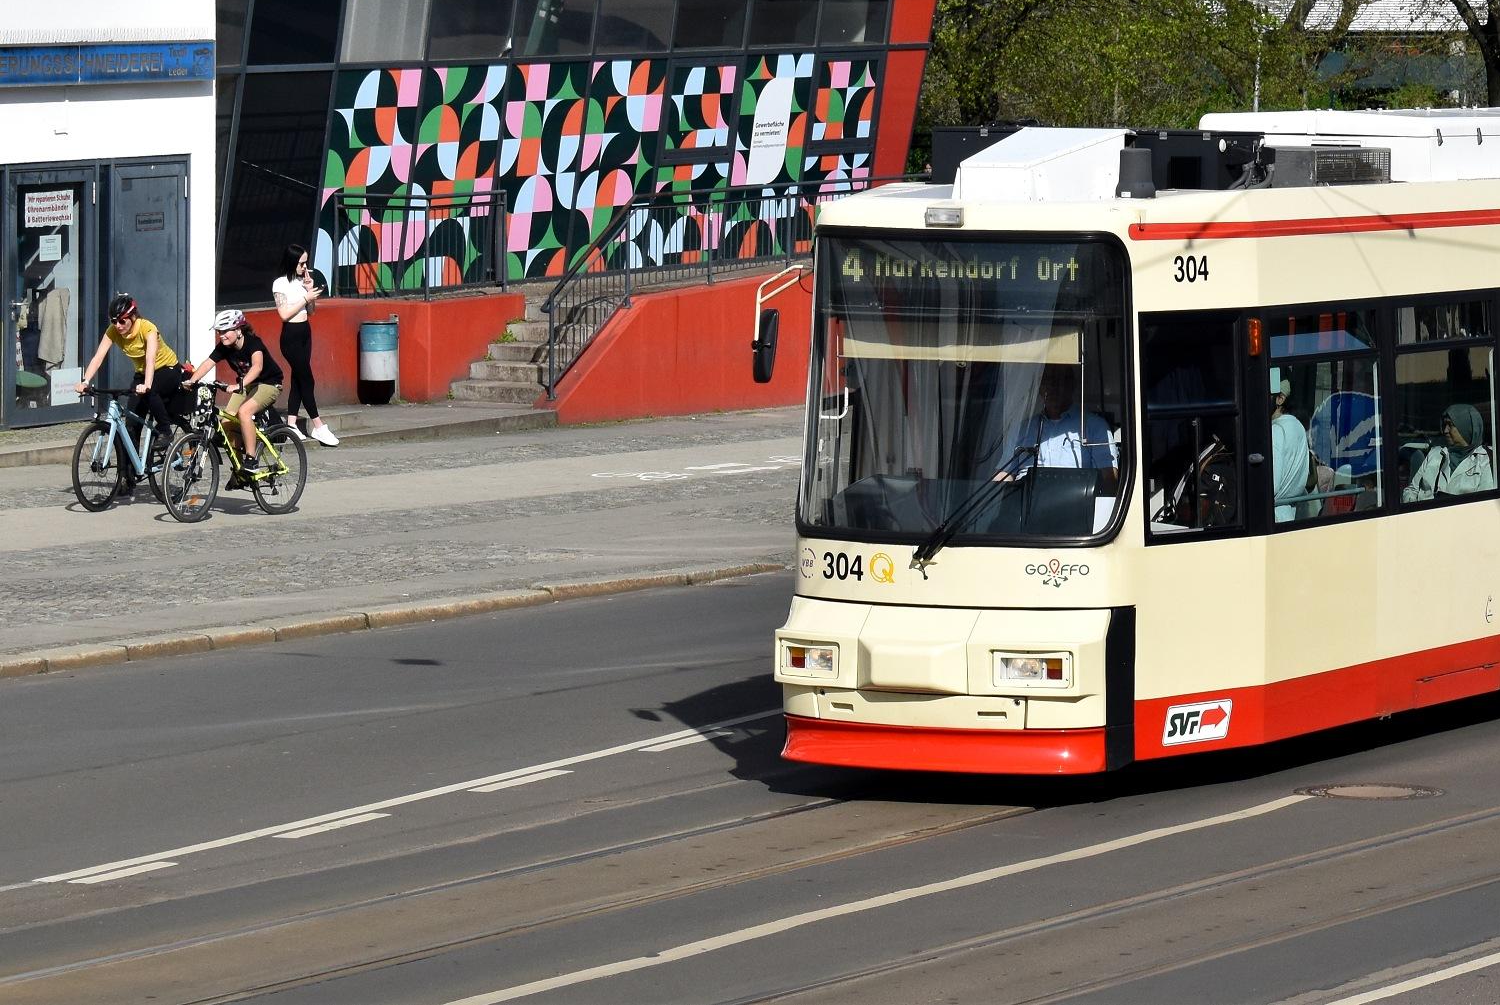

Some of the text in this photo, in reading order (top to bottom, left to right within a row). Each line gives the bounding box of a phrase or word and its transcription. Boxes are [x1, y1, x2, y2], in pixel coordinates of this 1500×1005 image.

[842, 250, 1079, 282] 4 Markendorf Ort
[1174, 255, 1209, 283] 304
[822, 551, 864, 581] 304
[1167, 710, 1200, 738] SVF
